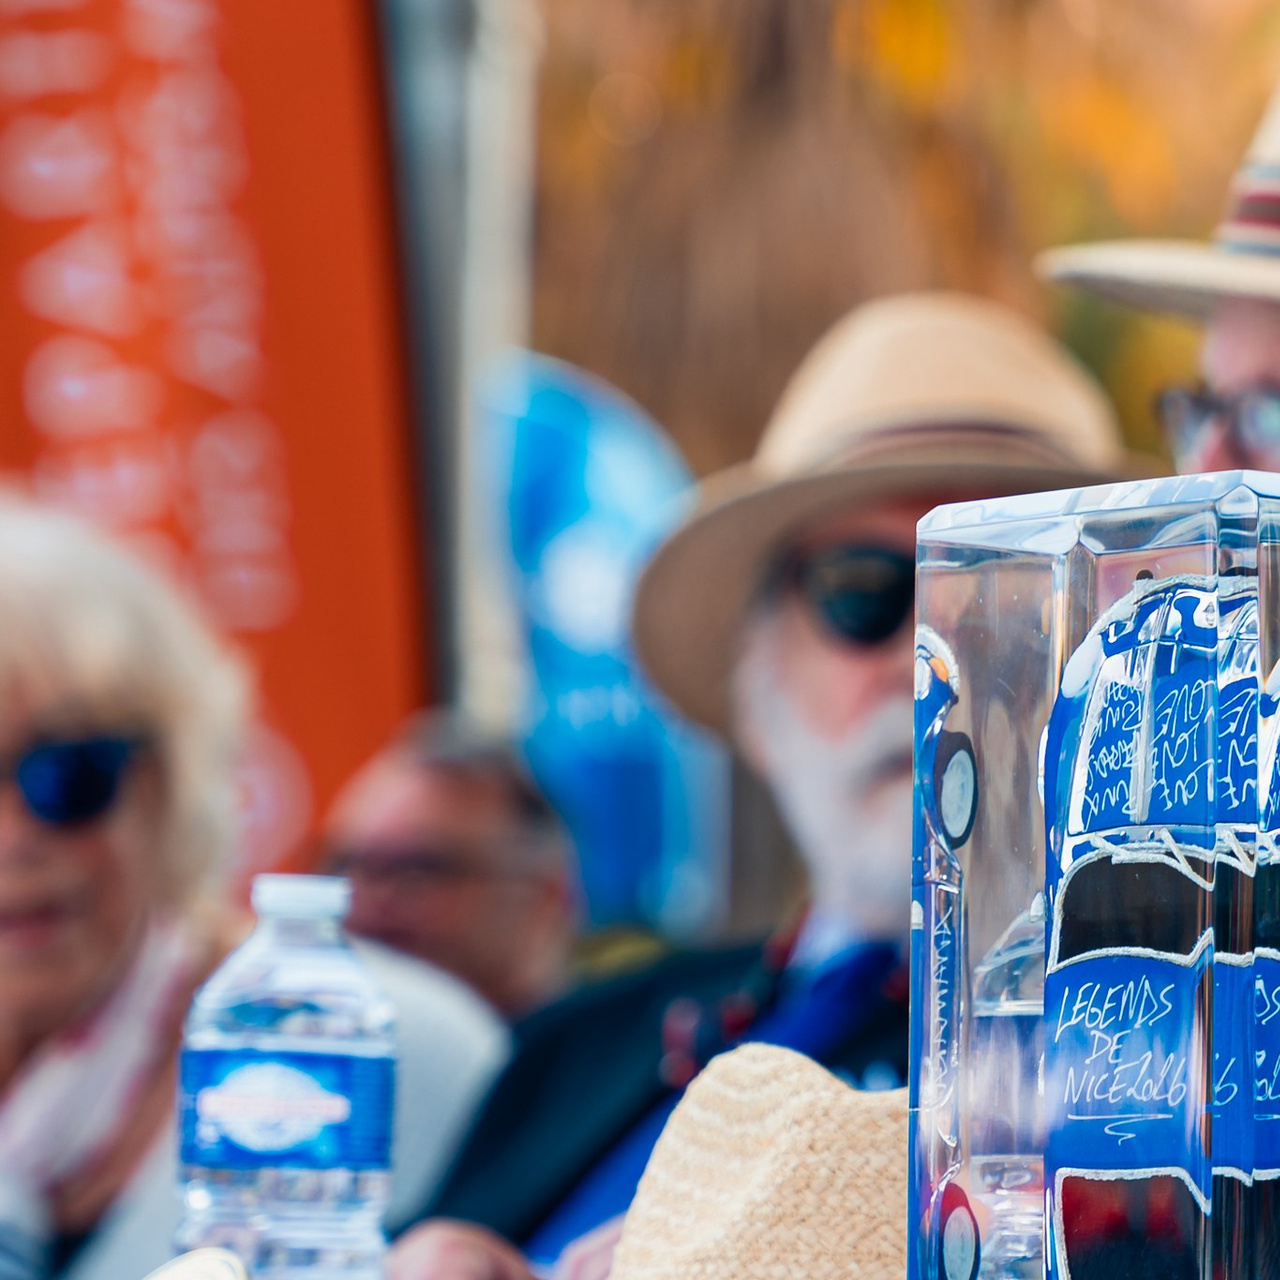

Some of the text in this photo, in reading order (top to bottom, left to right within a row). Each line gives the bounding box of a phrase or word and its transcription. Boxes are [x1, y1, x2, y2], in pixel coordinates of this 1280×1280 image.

[1054, 974, 1175, 1043] LEGENDS
[1084, 1029, 1132, 1065] DE
[1063, 1066, 1126, 1104] NICE
